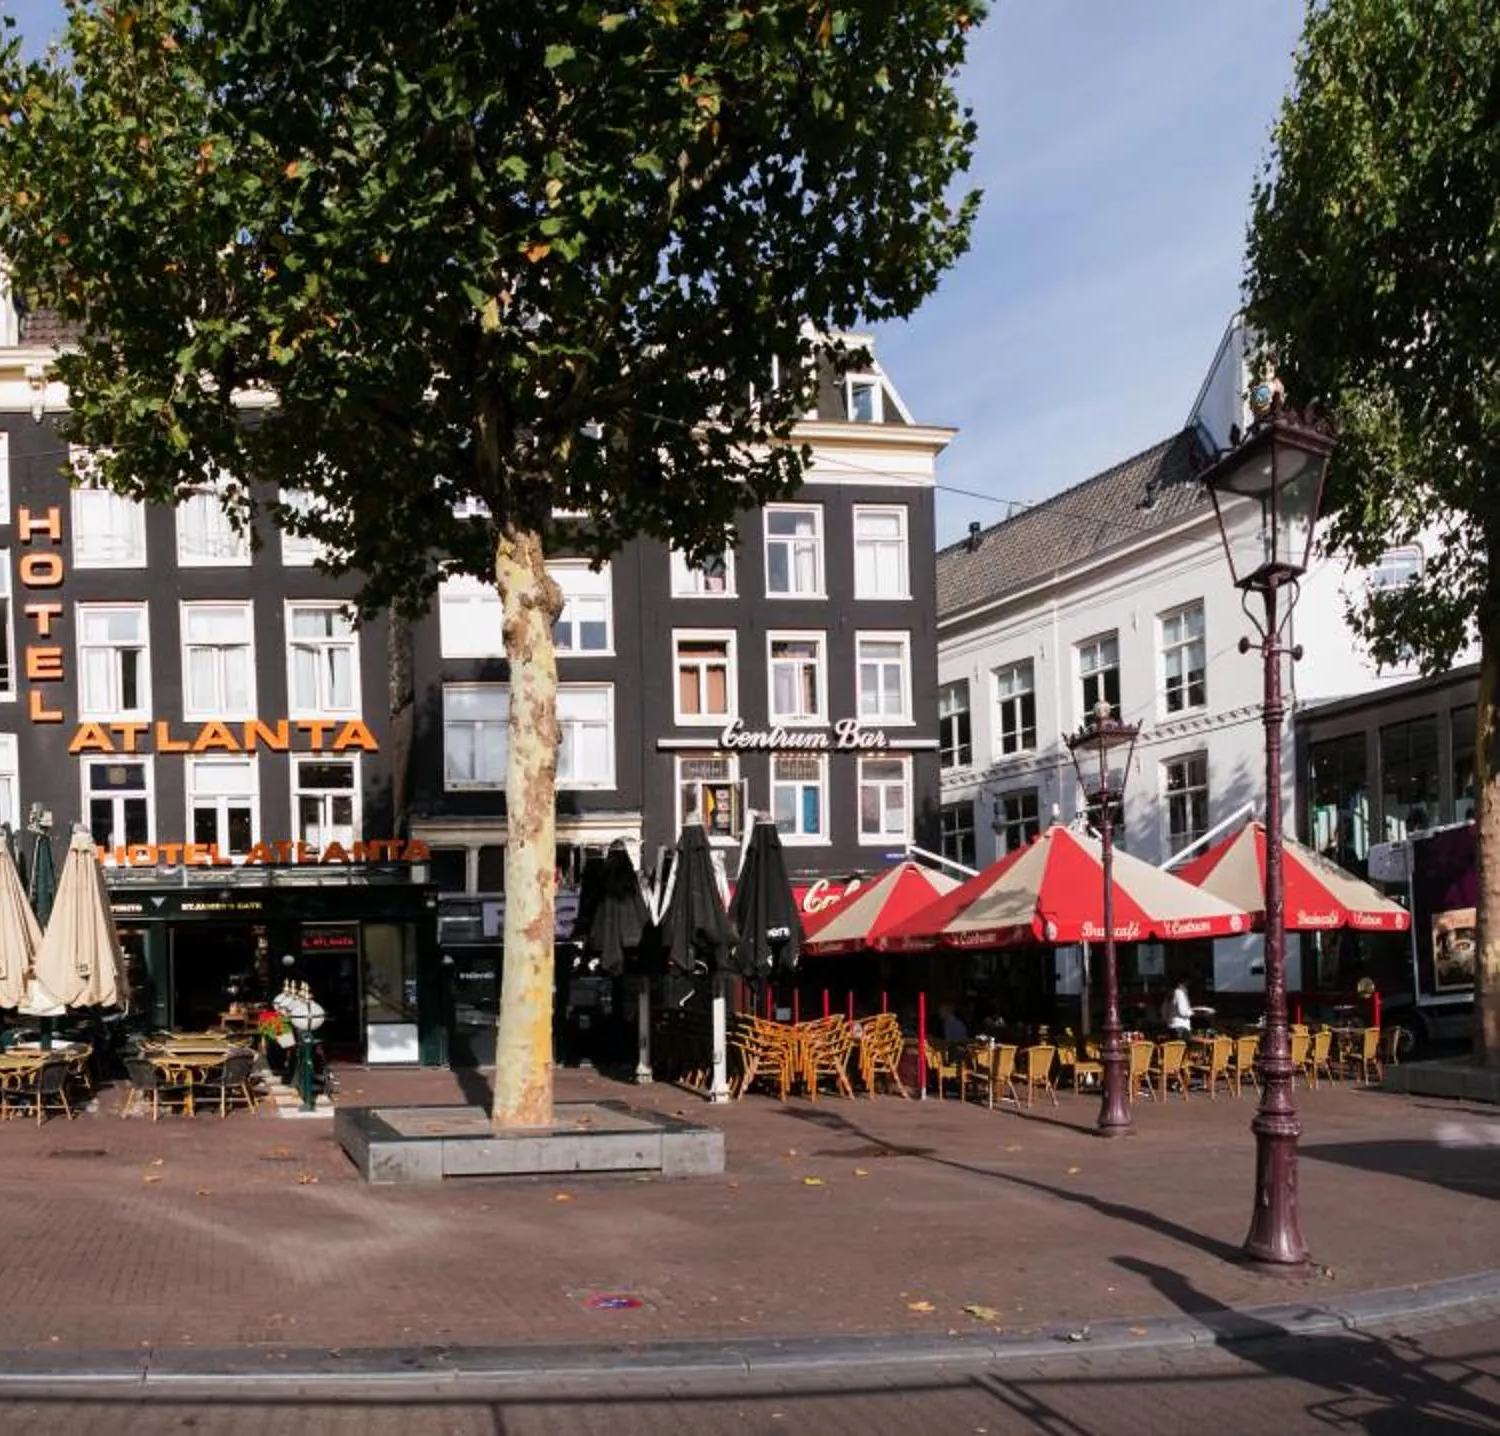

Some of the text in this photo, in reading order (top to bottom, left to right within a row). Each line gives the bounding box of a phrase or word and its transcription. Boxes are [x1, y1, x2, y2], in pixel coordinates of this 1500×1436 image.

[19, 506, 65, 723] HOTEL
[68, 720, 379, 753] ATLANTA
[721, 717, 887, 749] Centrum Bar
[96, 838, 431, 866] HOTEL ATLANTA
